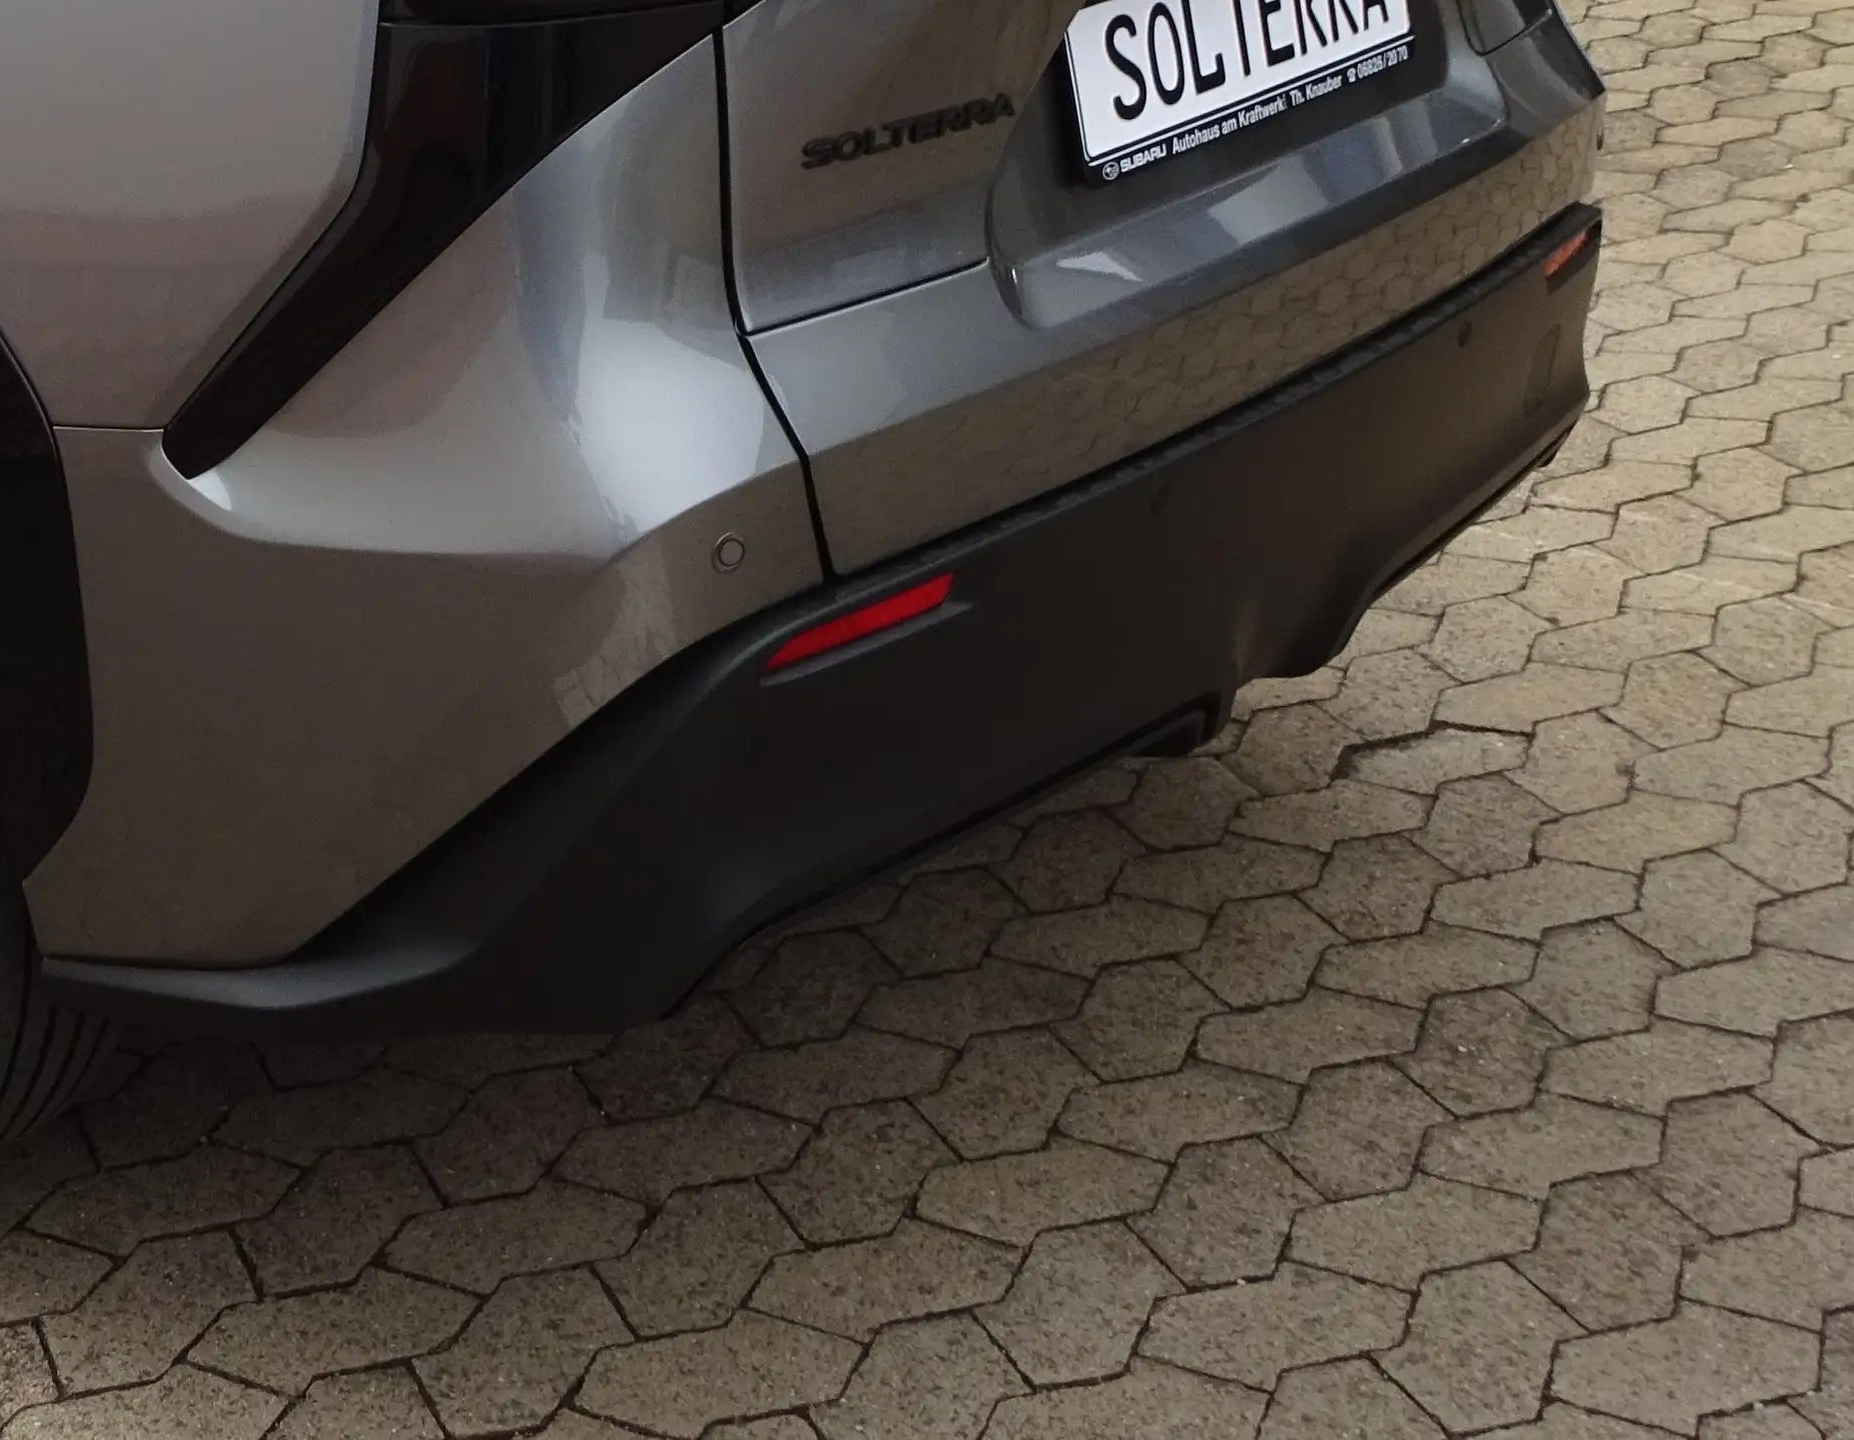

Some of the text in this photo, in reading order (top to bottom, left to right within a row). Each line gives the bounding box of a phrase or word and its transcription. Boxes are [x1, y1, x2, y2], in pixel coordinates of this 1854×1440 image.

[800, 92, 1016, 170] SOLTERRA
[1120, 143, 1167, 173] SUBARU
[1172, 124, 1220, 155] Autohaus
[1220, 118, 1238, 135] am
